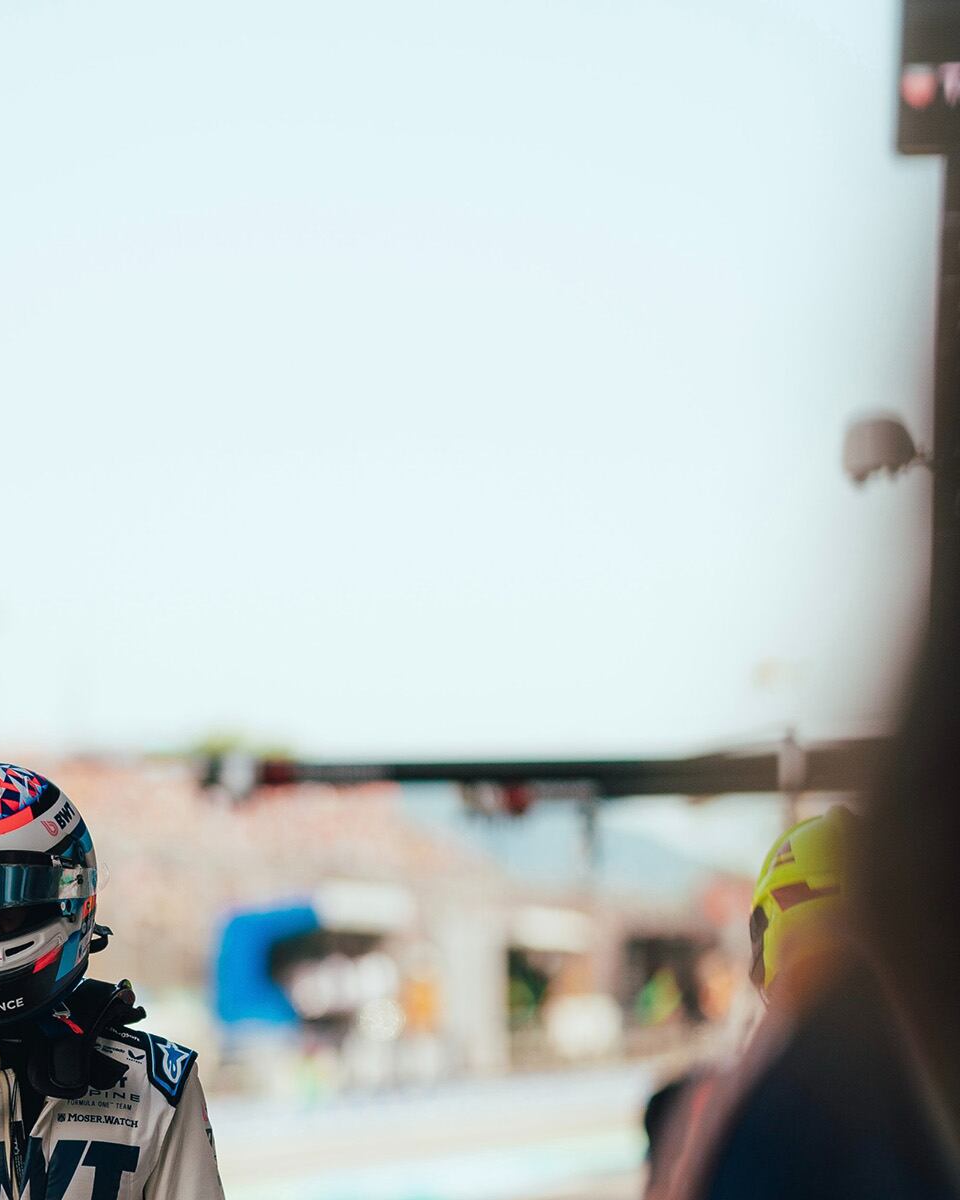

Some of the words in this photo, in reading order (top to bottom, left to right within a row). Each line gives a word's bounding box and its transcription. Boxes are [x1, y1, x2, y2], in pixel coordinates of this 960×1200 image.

[54, 801, 75, 829] BWT
[116, 1103, 132, 1111] TEAM
[67, 1113, 139, 1128] MOSER.WATCH
